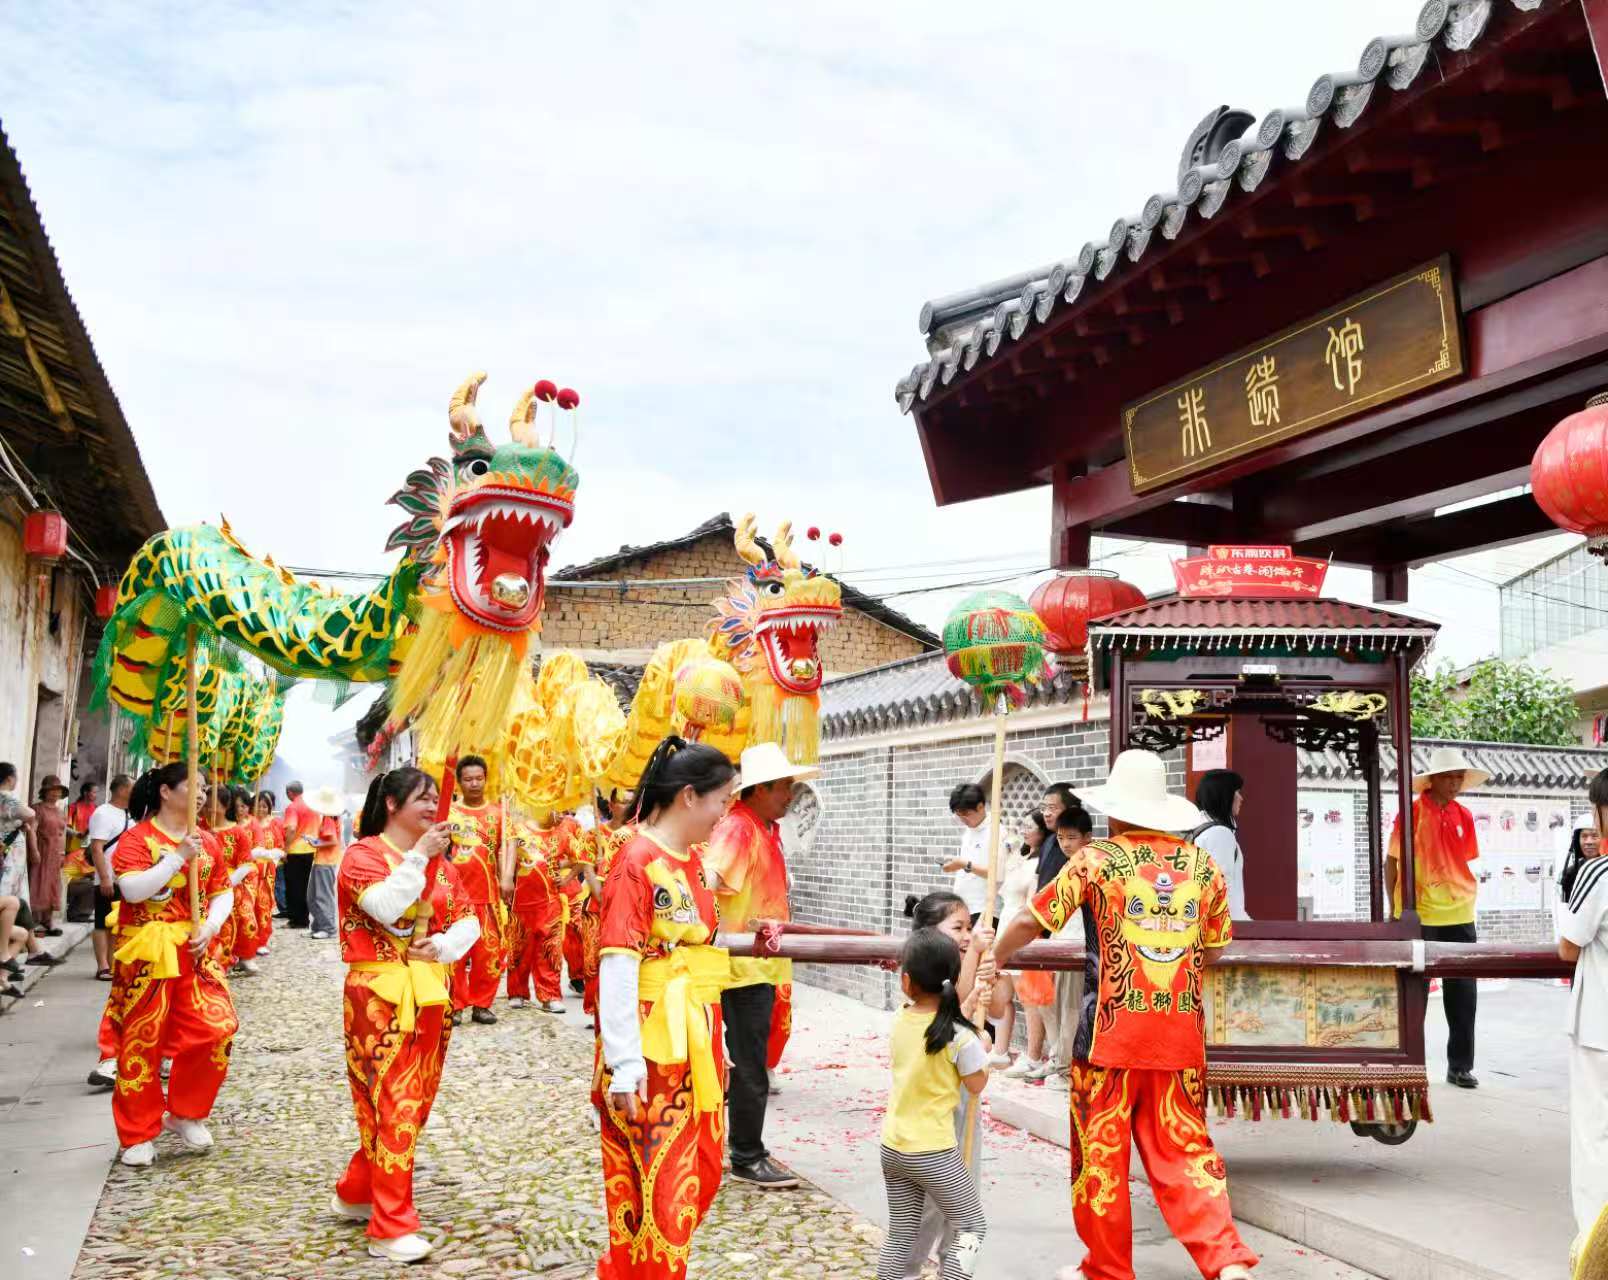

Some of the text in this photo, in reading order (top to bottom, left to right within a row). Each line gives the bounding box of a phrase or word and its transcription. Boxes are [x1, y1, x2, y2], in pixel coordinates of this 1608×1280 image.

[1177, 317, 1364, 457] 非遗馆
[1125, 990, 1192, 1014] 龍獅團
